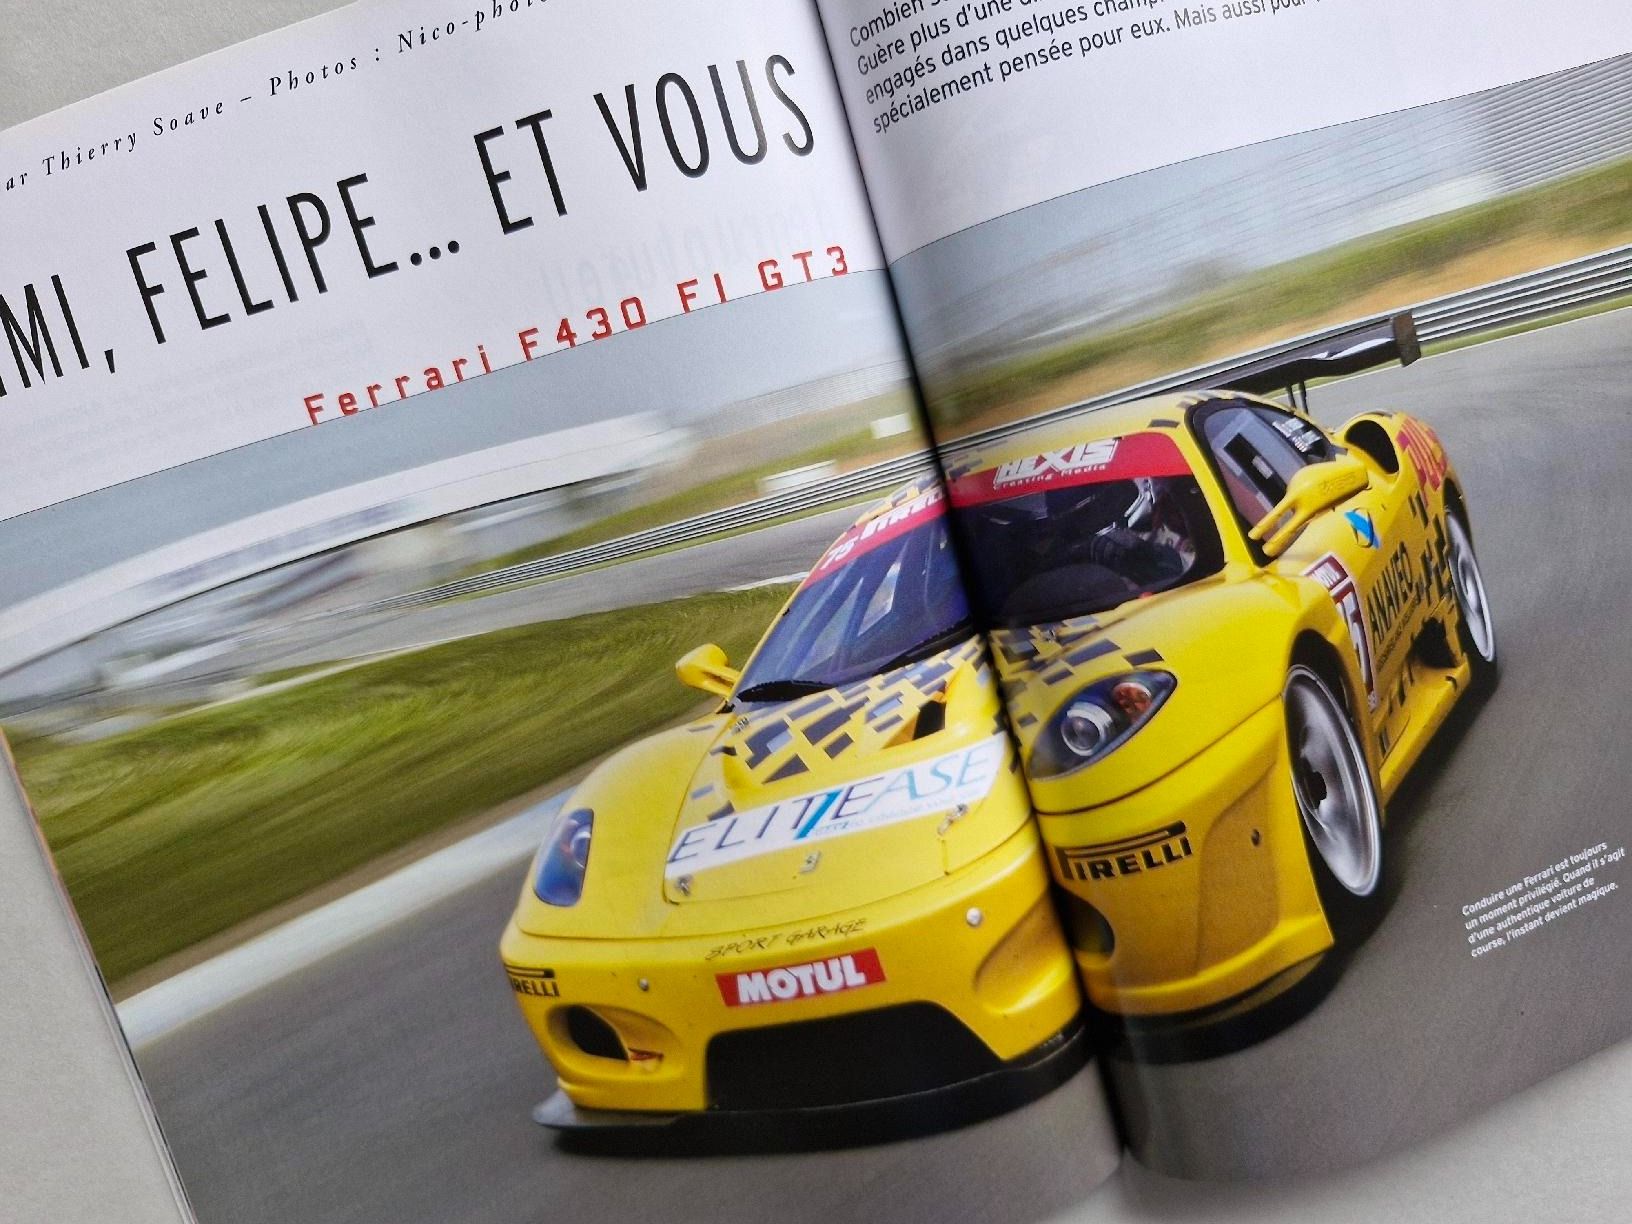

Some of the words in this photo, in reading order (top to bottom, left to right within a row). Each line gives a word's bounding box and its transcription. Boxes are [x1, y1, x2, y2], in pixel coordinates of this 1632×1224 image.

[849, 0, 925, 48] Combien
[857, 38, 906, 76] Guère
[909, 17, 951, 52] plus
[955, 0, 1013, 28] d'une
[865, 55, 937, 104] engagés
[941, 35, 990, 67] dans
[995, 5, 1088, 49] quelques
[42, 130, 138, 176] Thierry
[153, 100, 225, 136] Soave
[268, 56, 358, 97] Photos
[397, 0, 547, 54] Nico-pho
[873, 61, 994, 134] spécialement
[998, 38, 1074, 82] pensée
[1078, 26, 1124, 57] pour
[1130, 17, 1171, 39] eux.
[1173, 4, 1217, 30] Mais
[1221, 0, 1266, 20] aussi
[0, 273, 116, 398] MI,
[473, 108, 568, 236] ET
[592, 54, 815, 193] VOUS
[303, 344, 493, 427] Ferrari
[517, 295, 648, 362] F430
[757, 245, 850, 292] GT3
[1054, 820, 1193, 881] PIRELLI
[1461, 891, 1505, 917] Conduire
[1505, 881, 1524, 897] une
[1523, 865, 1555, 888] Ferrari
[1555, 858, 1570, 872] est
[1570, 842, 1608, 865] toujours
[1465, 918, 1478, 930] un
[1479, 899, 1518, 923] moment
[1562, 863, 1592, 883] Quand
[1592, 859, 1600, 870] il
[1600, 847, 1625, 866] s'agit
[1468, 925, 1495, 944] d'une
[1496, 899, 1551, 931] authentique
[1551, 883, 1582, 904] voiture
[1583, 876, 1595, 888] de
[1471, 936, 1507, 958] course,
[1506, 916, 1544, 941] l'instant
[1544, 899, 1578, 922] devient
[1578, 881, 1619, 906] magique.
[736, 953, 867, 1005] MOTUL
